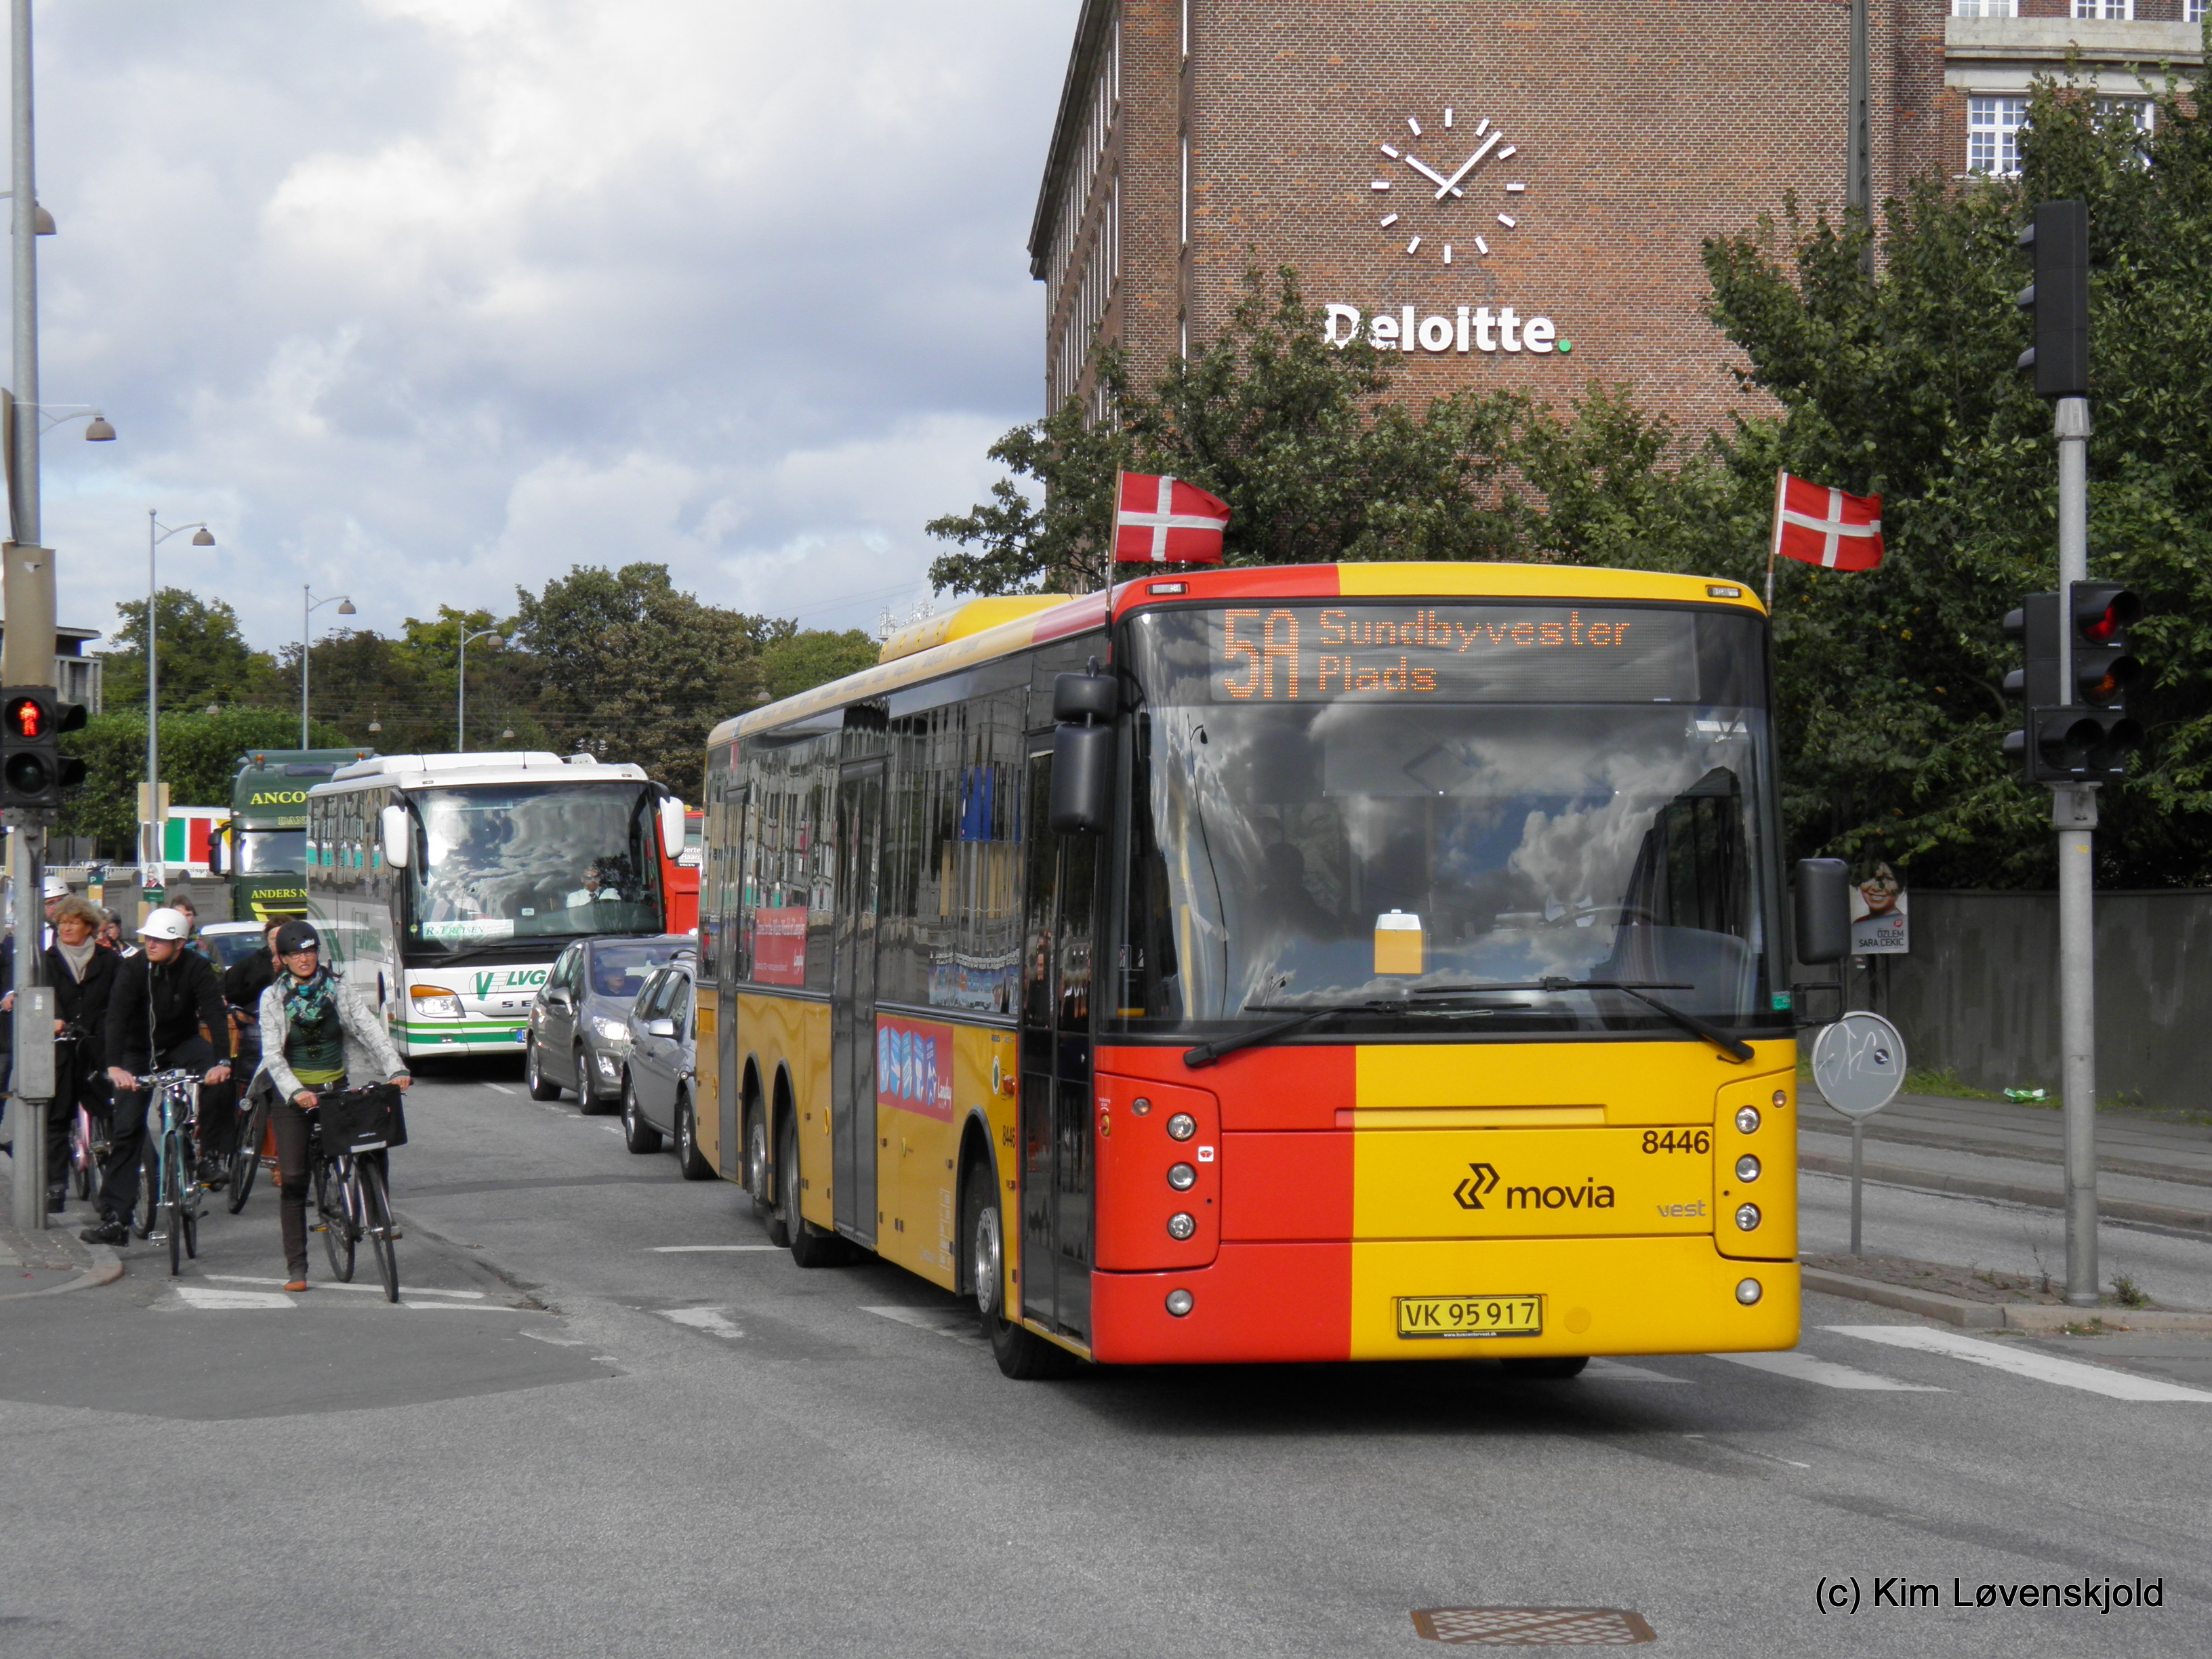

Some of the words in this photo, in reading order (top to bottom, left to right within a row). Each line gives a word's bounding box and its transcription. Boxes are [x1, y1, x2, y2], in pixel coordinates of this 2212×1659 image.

[1324, 304, 1572, 353] Deloitte.
[1224, 609, 1298, 698] 5A
[1319, 610, 1630, 653] Sundbyvester
[1318, 656, 1437, 691] Plads
[250, 791, 308, 805] ANCO
[278, 815, 308, 825] DAN
[251, 888, 297, 899] ANDERS
[1859, 939, 1879, 947] SARA
[1877, 928, 1904, 938] ÖZLEM
[506, 970, 546, 986] LVG
[1002, 1124, 1016, 1149] 8446
[1642, 1130, 1711, 1154] 8446
[1507, 1177, 1615, 1209] movia
[1657, 1199, 1706, 1217] vest
[1406, 1304, 1441, 1326] VK
[1449, 1303, 1480, 1326] 95
[1487, 1302, 1535, 1326] 917
